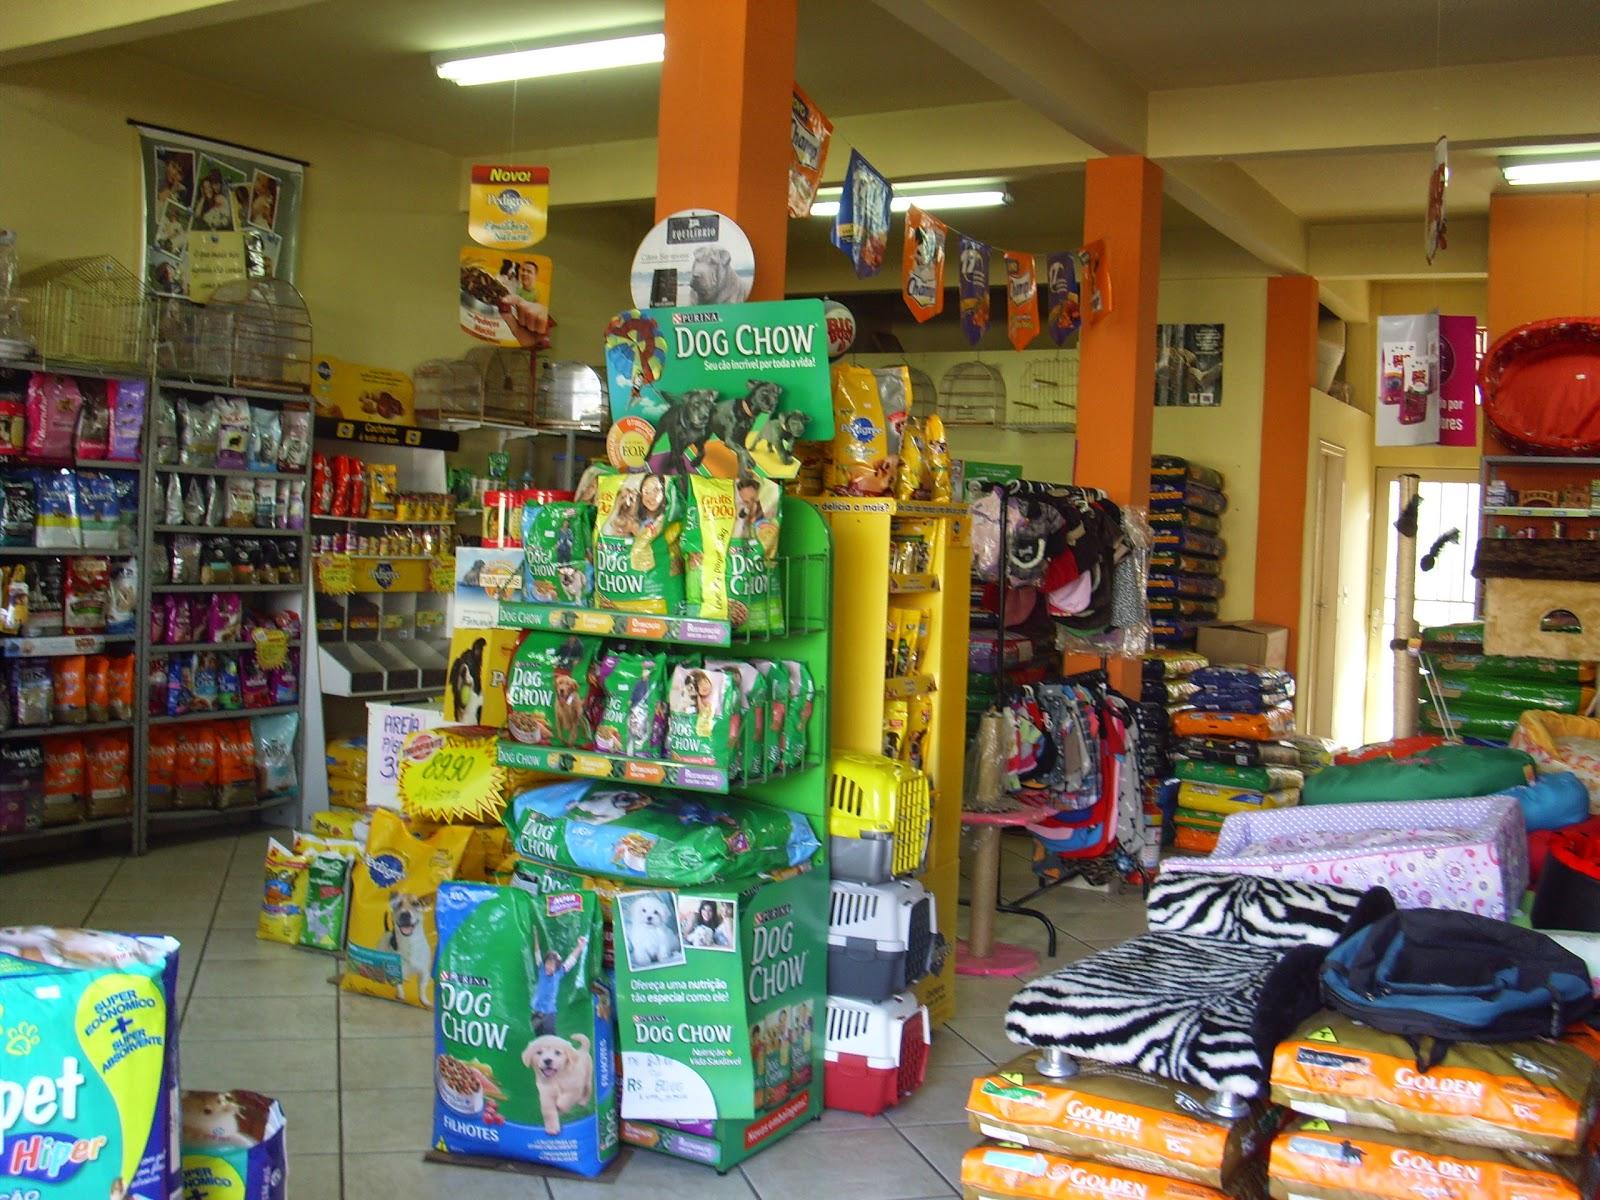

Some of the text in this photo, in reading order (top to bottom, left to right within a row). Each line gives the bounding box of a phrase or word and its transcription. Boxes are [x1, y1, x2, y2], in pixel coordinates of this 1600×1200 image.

[490, 168, 531, 182] Novo!
[681, 312, 719, 322] PURINA
[675, 324, 815, 358] DOG CHOW
[704, 360, 718, 371] Seu
[760, 359, 772, 371] por
[598, 550, 628, 573] DOG
[731, 554, 765, 575] DOG
[598, 571, 644, 594] CHOW
[514, 667, 541, 687] DOG
[511, 687, 552, 708] CHOW
[523, 819, 557, 841] DOG
[521, 834, 558, 860] CHOW
[751, 921, 793, 965] DOG
[631, 979, 727, 992] Ofereça uma nutrição
[749, 951, 808, 1004] CHOW
[94, 990, 137, 1014] SUPER
[441, 981, 492, 1018] DOG
[648, 993, 684, 1005] especial
[686, 994, 712, 1003] como
[441, 1011, 509, 1051] CHOW
[635, 1022, 733, 1043] DOG CHOW
[1394, 1067, 1483, 1098] GOLDEN
[1065, 1099, 1142, 1133] GOLDEN
[443, 1115, 499, 1143] FILHOTES
[10, 1134, 107, 1178] Hiper
[1390, 1149, 1481, 1181] GOLDEN
[1069, 1167, 1149, 1200] GOLDEN
